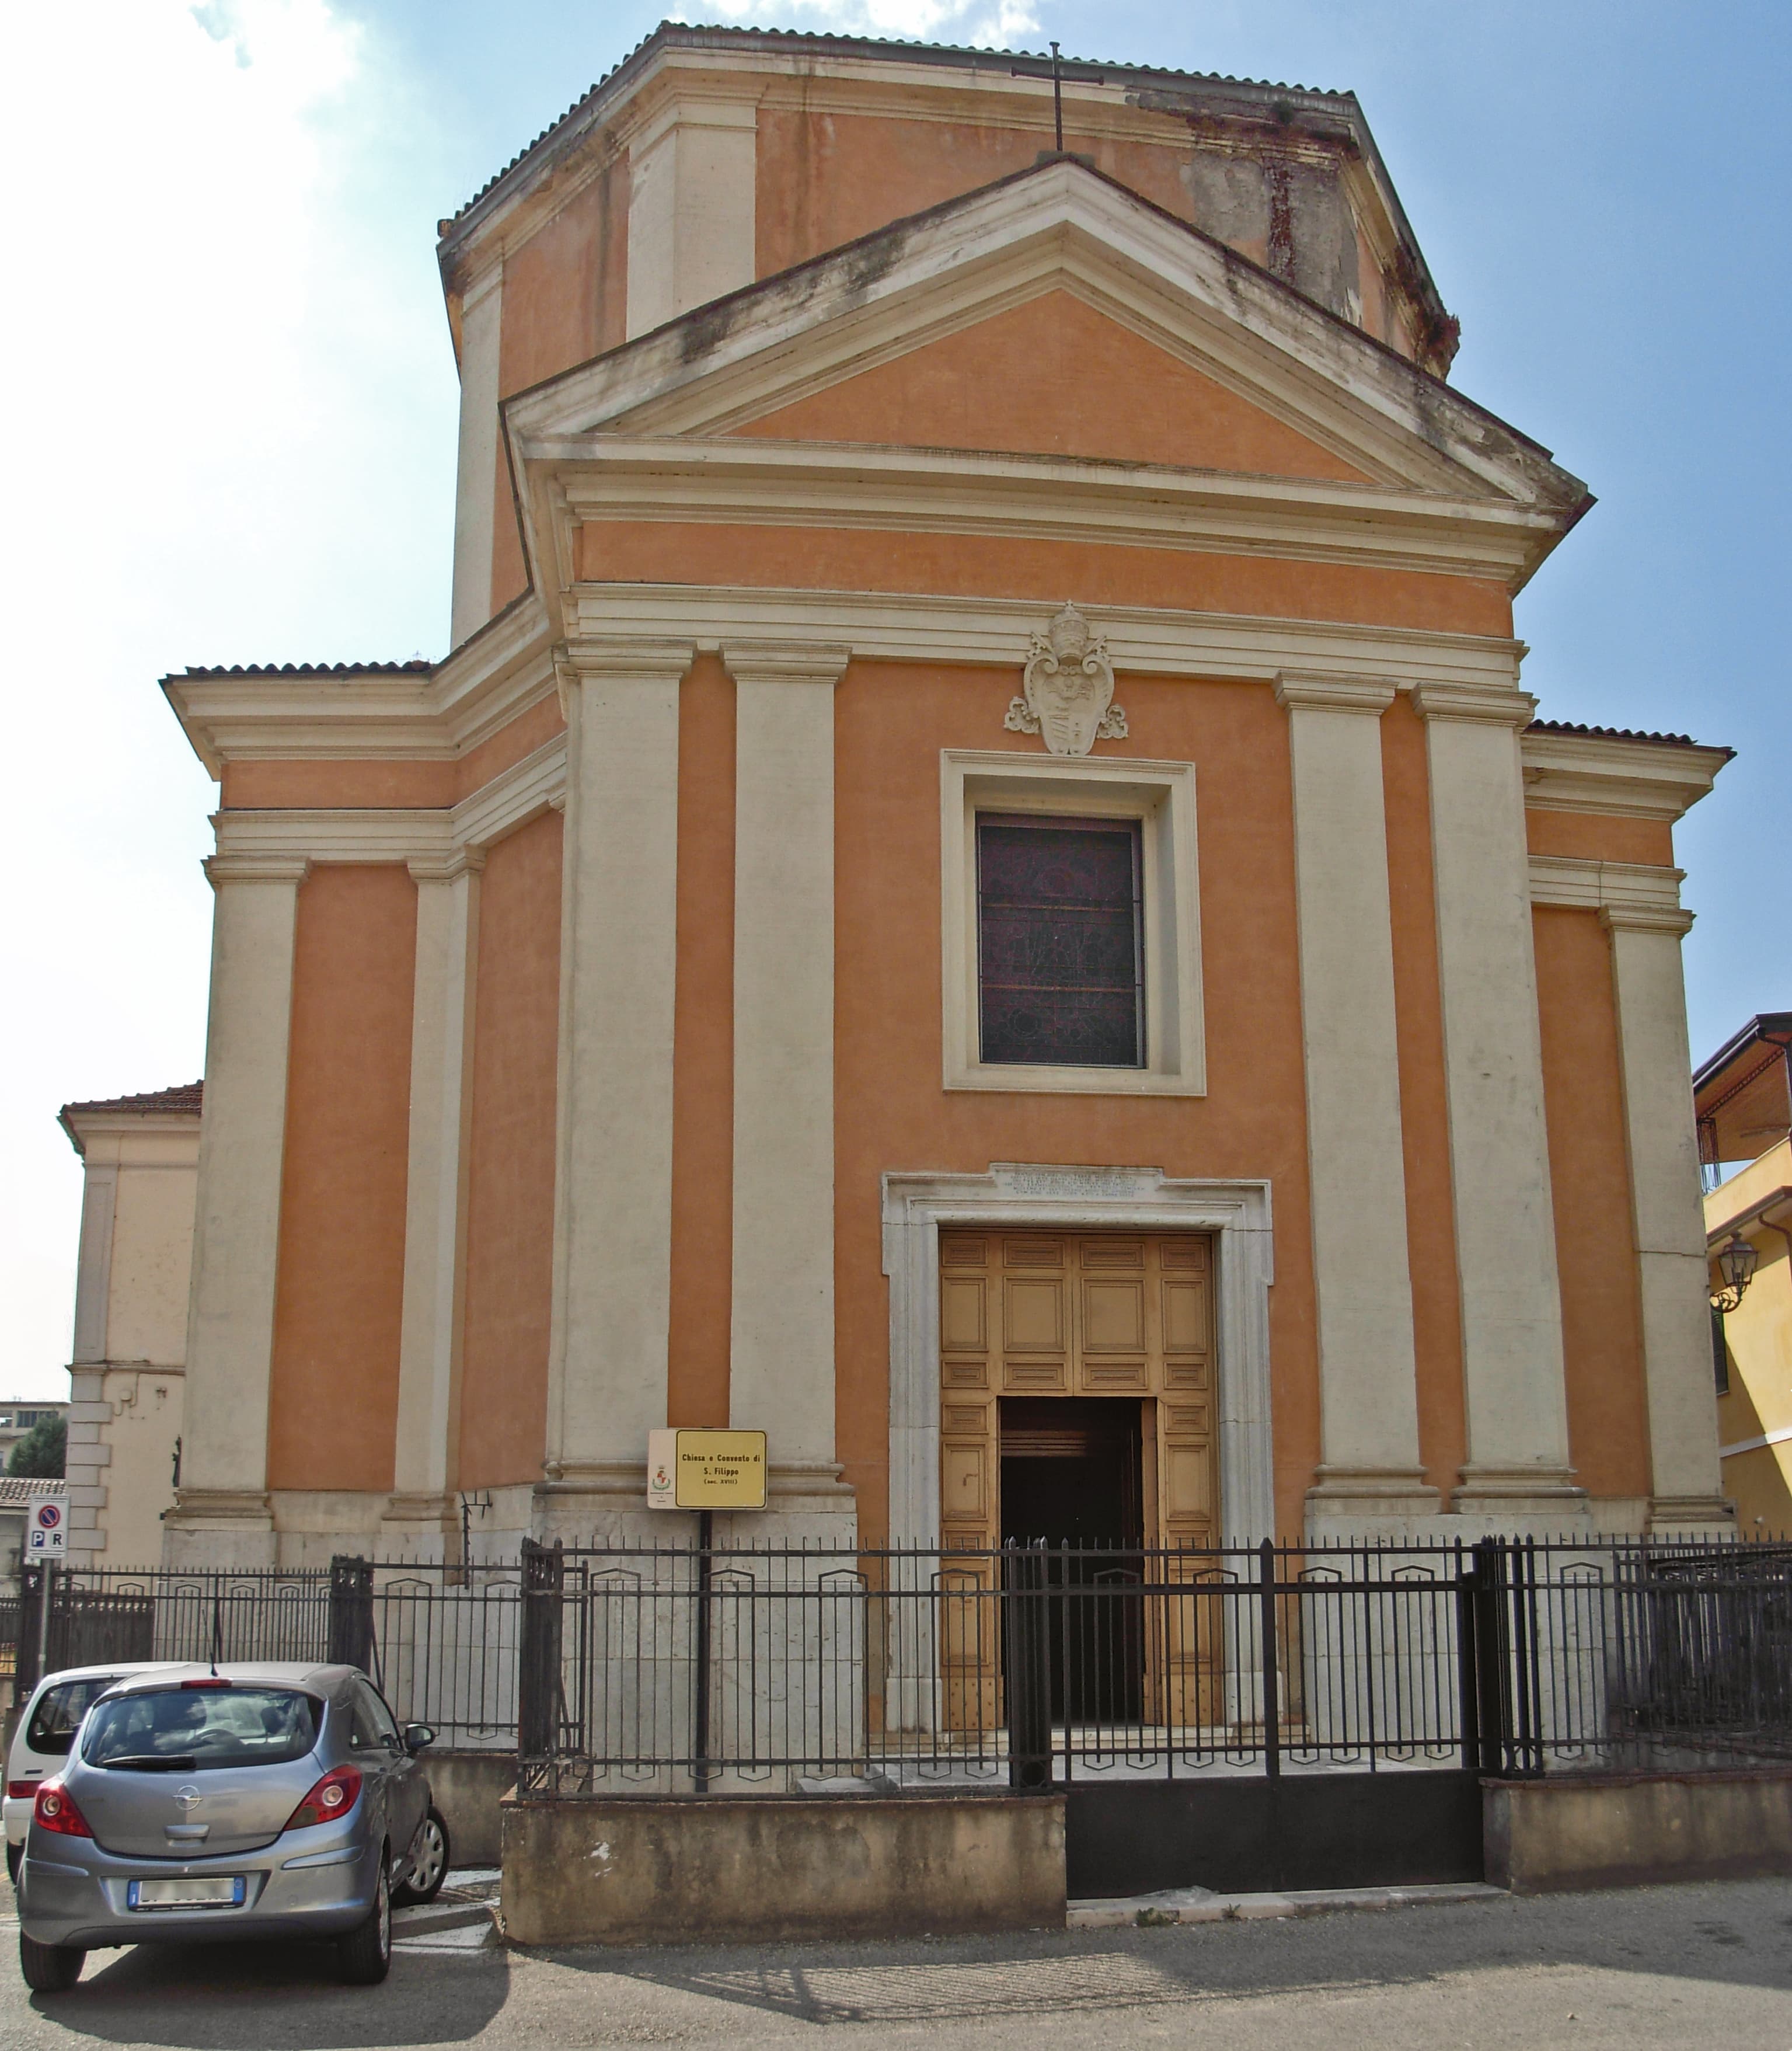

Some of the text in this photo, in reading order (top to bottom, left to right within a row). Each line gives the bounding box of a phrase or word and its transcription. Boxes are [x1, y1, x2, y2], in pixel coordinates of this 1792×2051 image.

[714, 1467, 738, 1476] Filippo
[33, 1532, 62, 1545] P R
